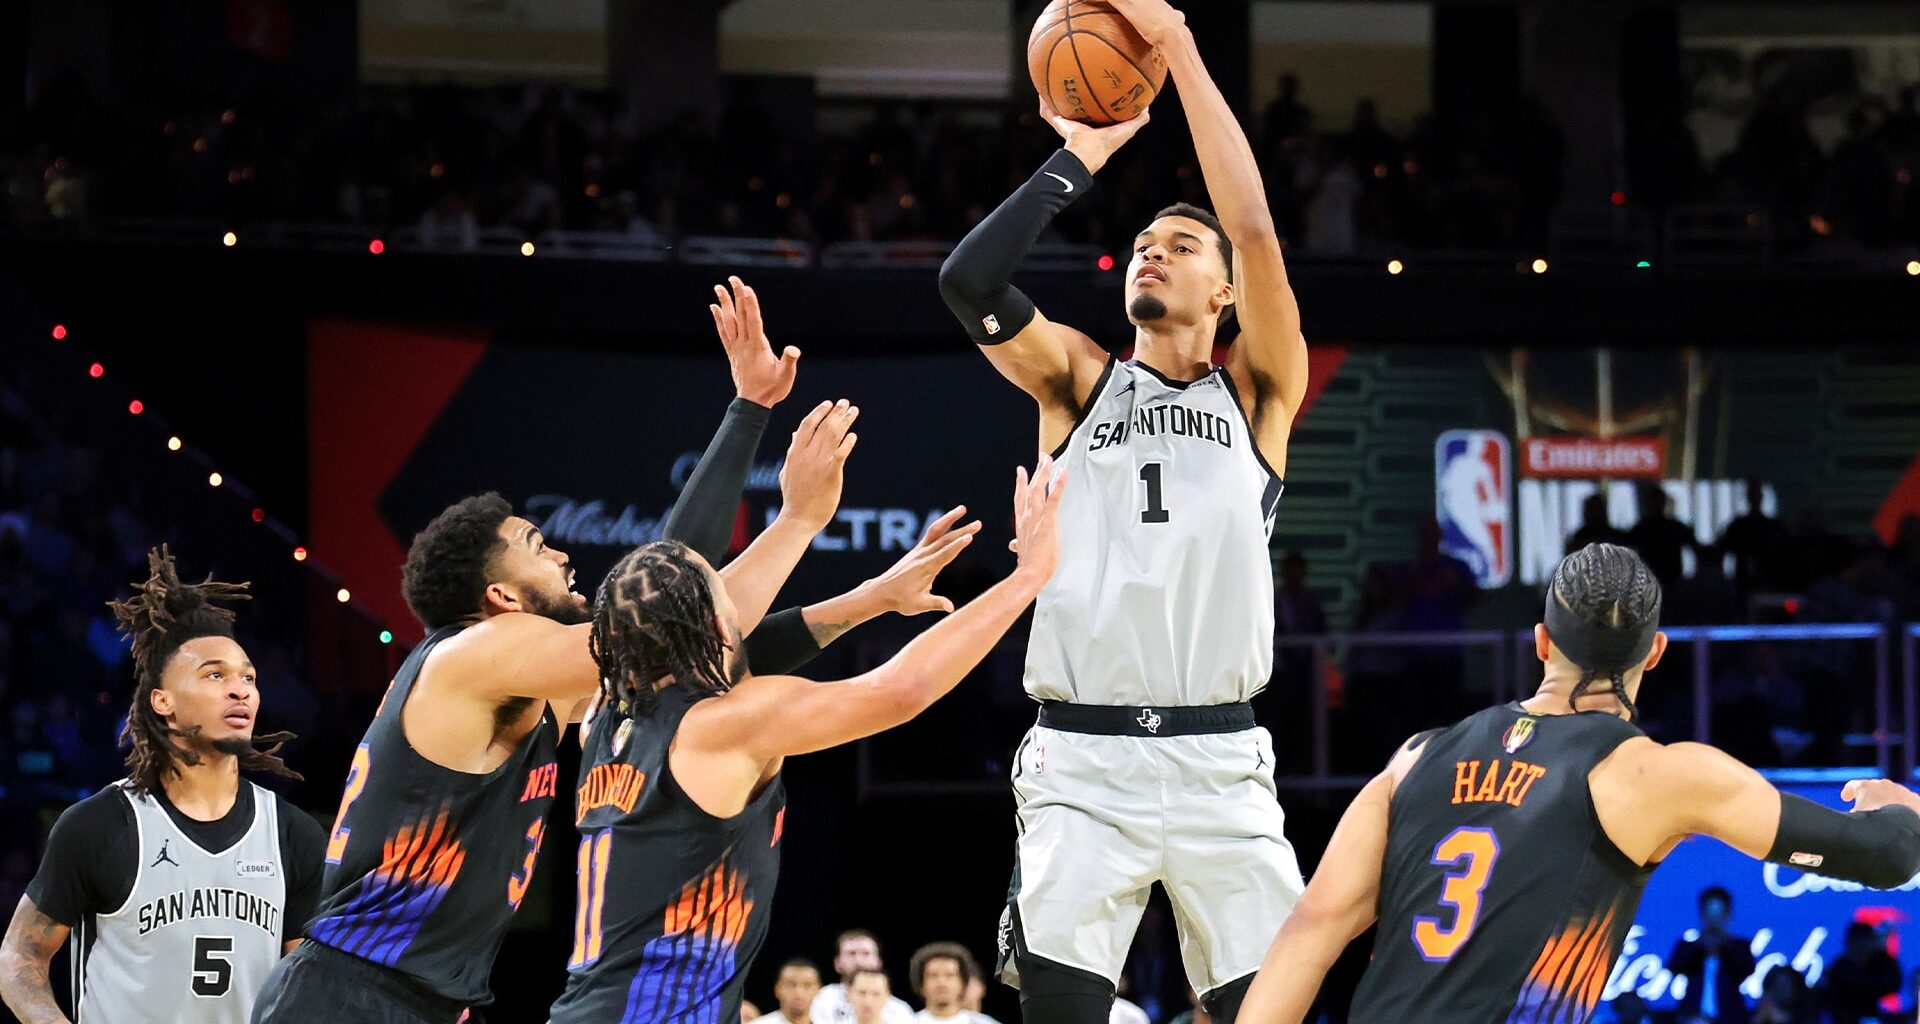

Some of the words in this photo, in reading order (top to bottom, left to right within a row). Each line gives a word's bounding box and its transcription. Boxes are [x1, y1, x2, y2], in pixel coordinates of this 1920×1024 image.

[1139, 462, 1170, 524] 1
[1451, 759, 1547, 808] HART
[241, 865, 270, 873] LEDGER
[567, 827, 612, 972] 11
[1411, 825, 1501, 963] 3
[138, 891, 184, 936] SAN
[189, 888, 279, 937] ANTONIO
[191, 936, 234, 997] 5
